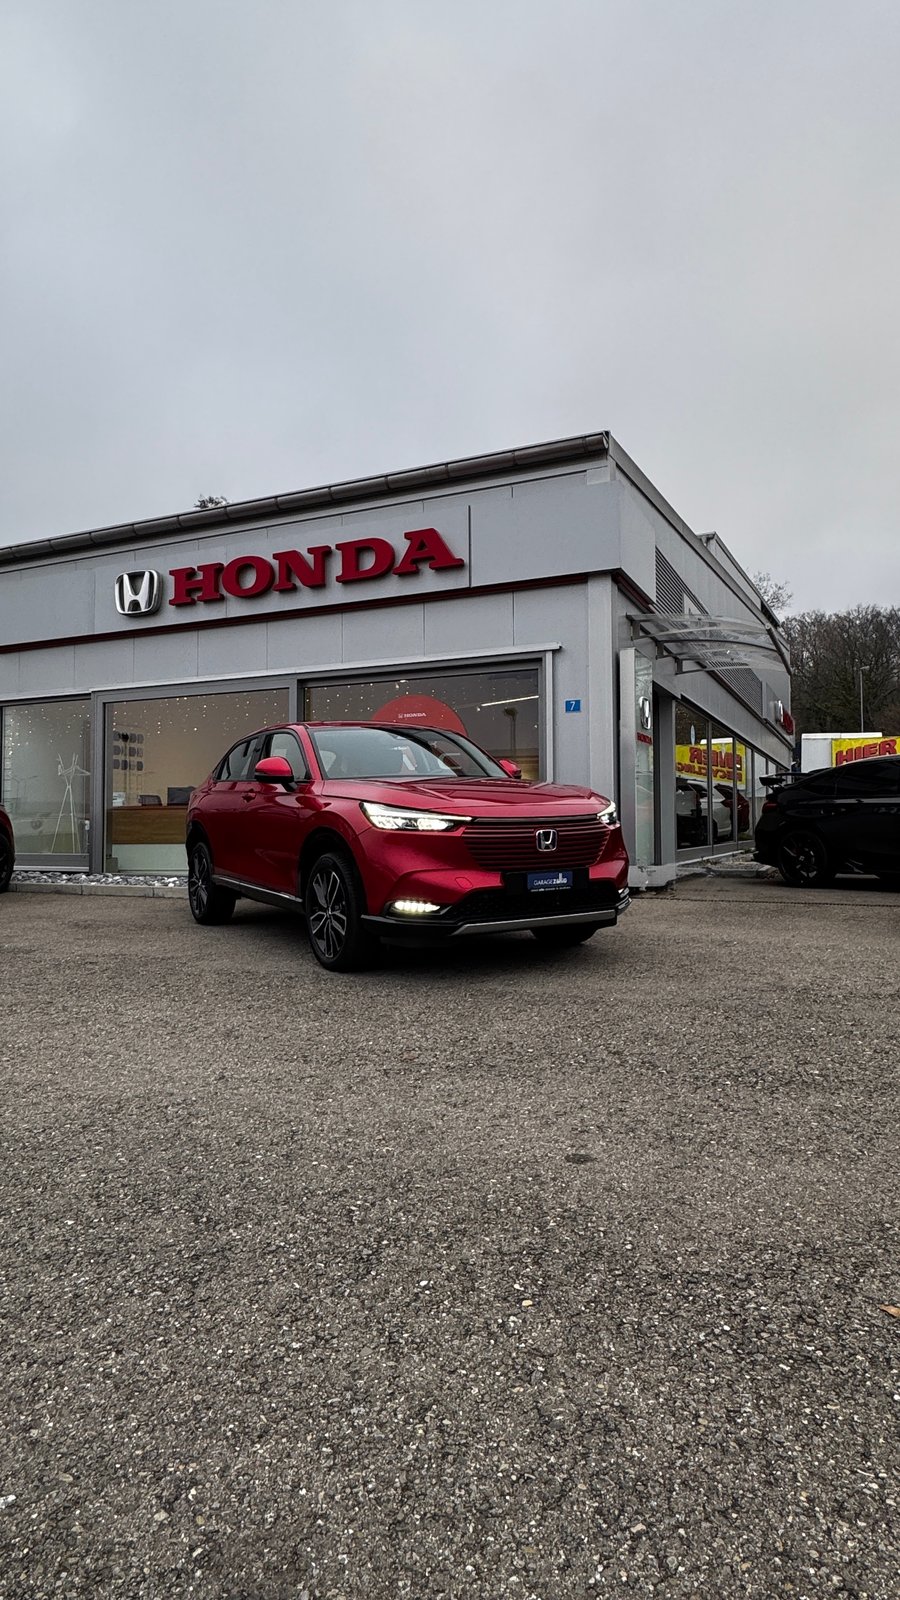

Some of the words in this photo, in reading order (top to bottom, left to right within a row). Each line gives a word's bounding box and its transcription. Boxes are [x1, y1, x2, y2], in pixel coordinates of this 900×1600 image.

[168, 527, 465, 607] HONDA
[570, 701, 576, 711] 7
[836, 739, 897, 766] HIER
